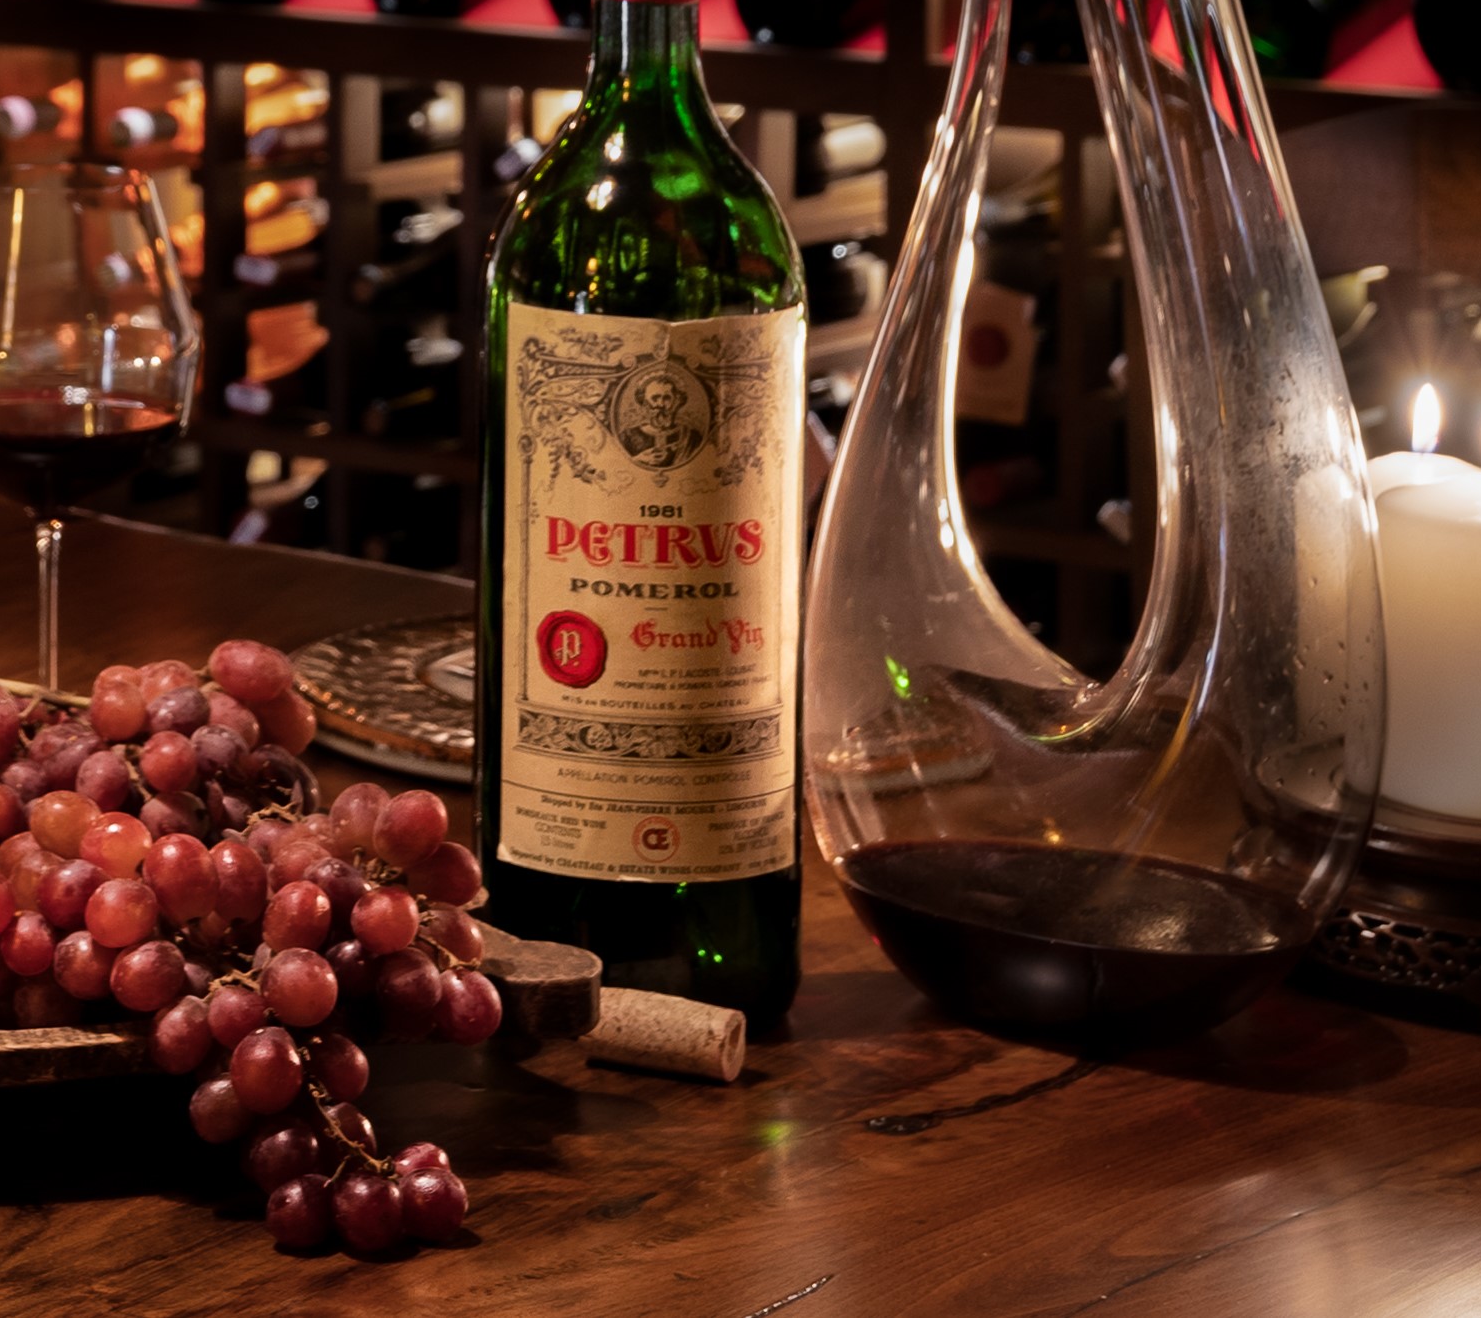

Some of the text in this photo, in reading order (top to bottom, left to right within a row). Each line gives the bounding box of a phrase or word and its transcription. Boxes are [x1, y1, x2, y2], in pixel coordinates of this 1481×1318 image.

[639, 505, 683, 518] 1981
[570, 578, 739, 600] POMEROL
[630, 616, 718, 651] Grand
